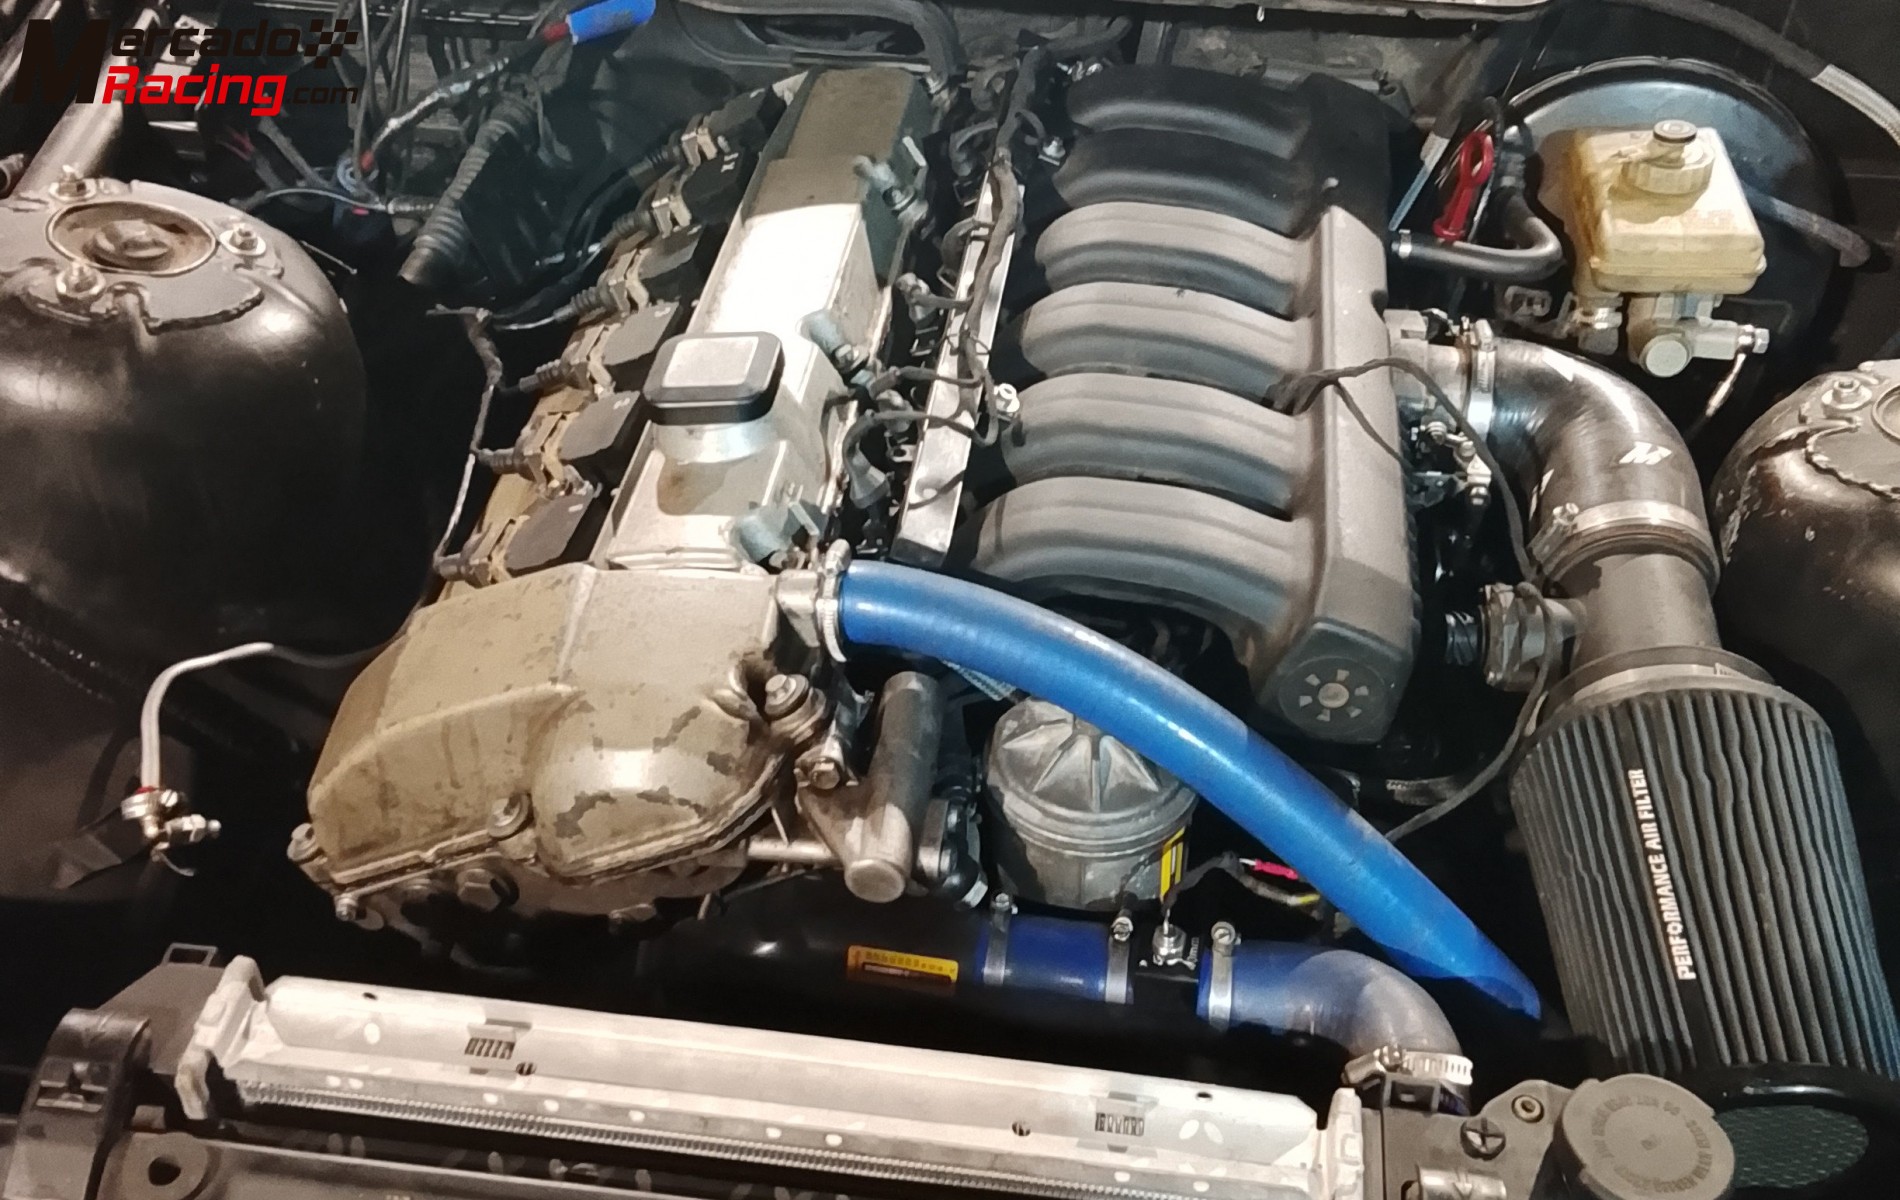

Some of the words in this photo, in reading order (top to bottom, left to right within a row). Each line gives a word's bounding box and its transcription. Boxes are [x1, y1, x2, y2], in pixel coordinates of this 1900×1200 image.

[1628, 768, 1656, 820] FILTER
[1641, 820, 1663, 850] AIR
[1648, 852, 1697, 981] PERFORMANCE
